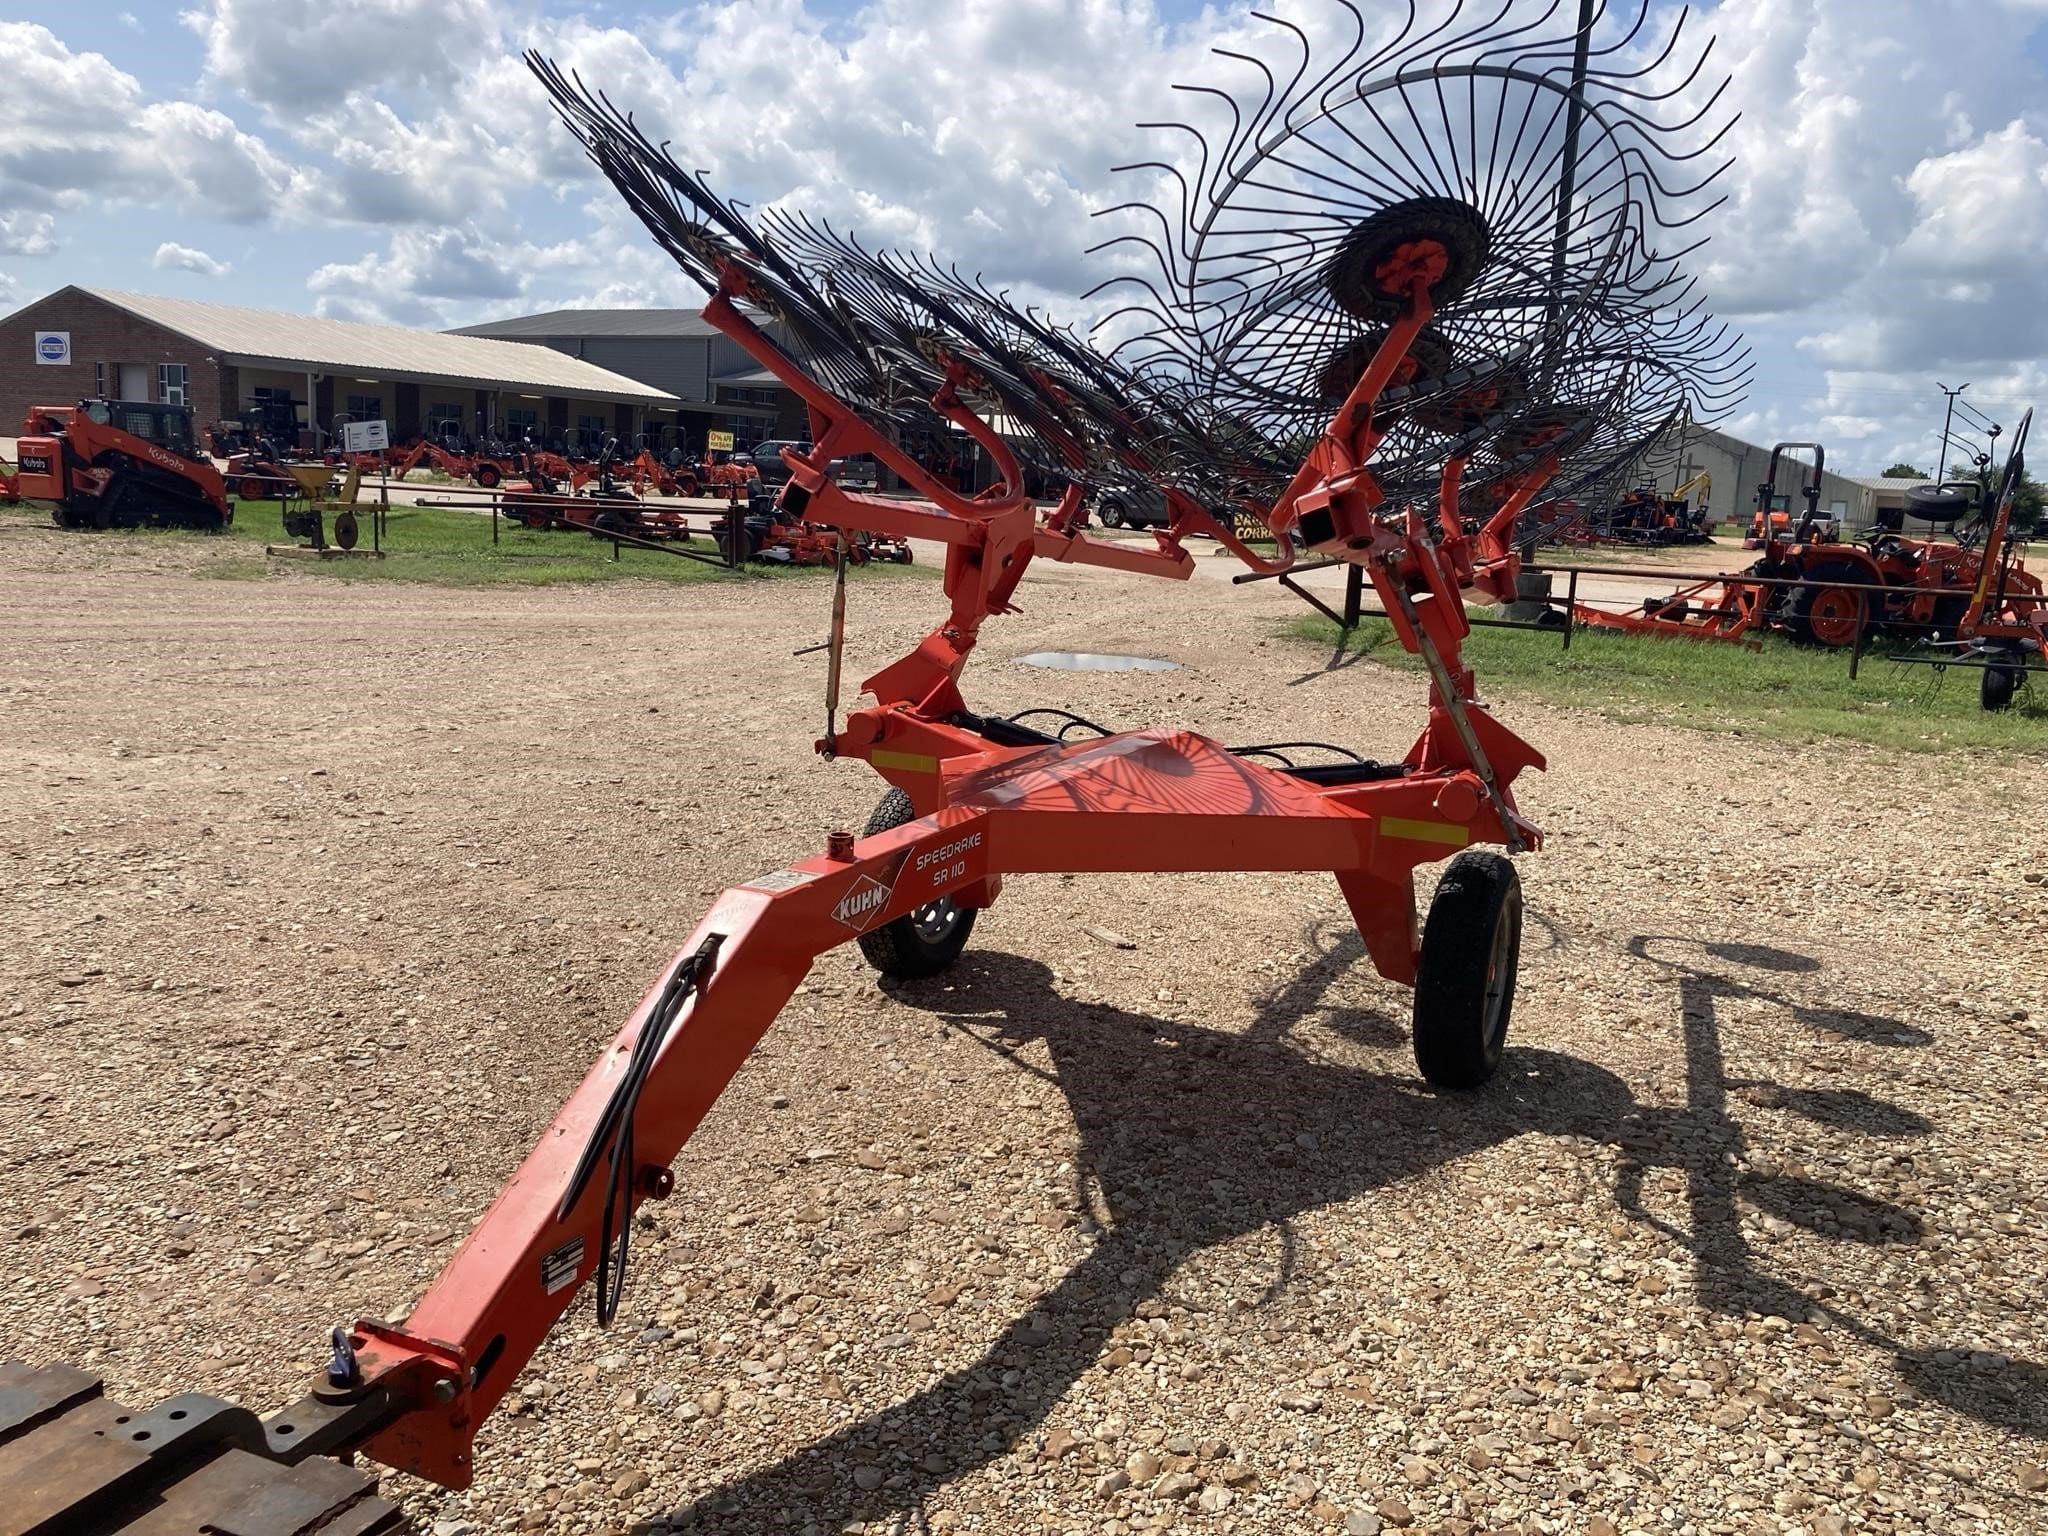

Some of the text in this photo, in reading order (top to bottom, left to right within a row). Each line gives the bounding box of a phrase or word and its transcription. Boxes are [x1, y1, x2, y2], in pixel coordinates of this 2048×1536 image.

[711, 432, 722, 442] 0%
[23, 457, 46, 469] Kubota
[148, 446, 185, 471] Kubota
[1235, 526, 1275, 540] CORRA
[916, 832, 982, 871] SPEEDRAKE
[933, 861, 965, 887] SR 110
[839, 885, 884, 921] KUHN
